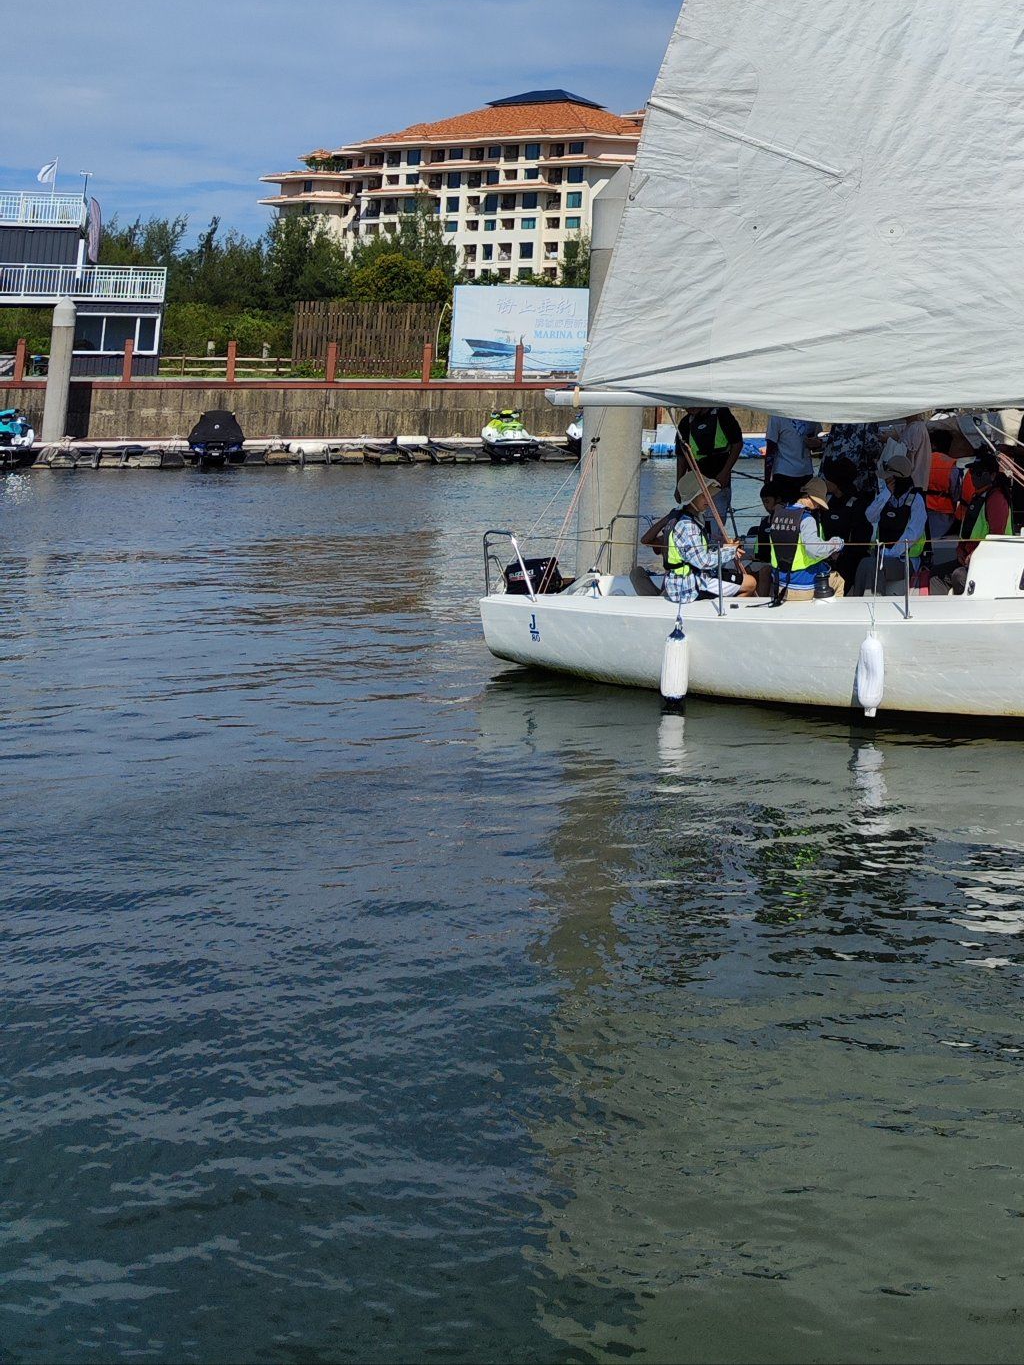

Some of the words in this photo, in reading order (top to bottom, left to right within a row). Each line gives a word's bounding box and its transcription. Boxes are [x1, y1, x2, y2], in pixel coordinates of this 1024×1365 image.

[534, 330, 573, 339] MARINA
[529, 614, 536, 630] J
[531, 634, 541, 642] 80
